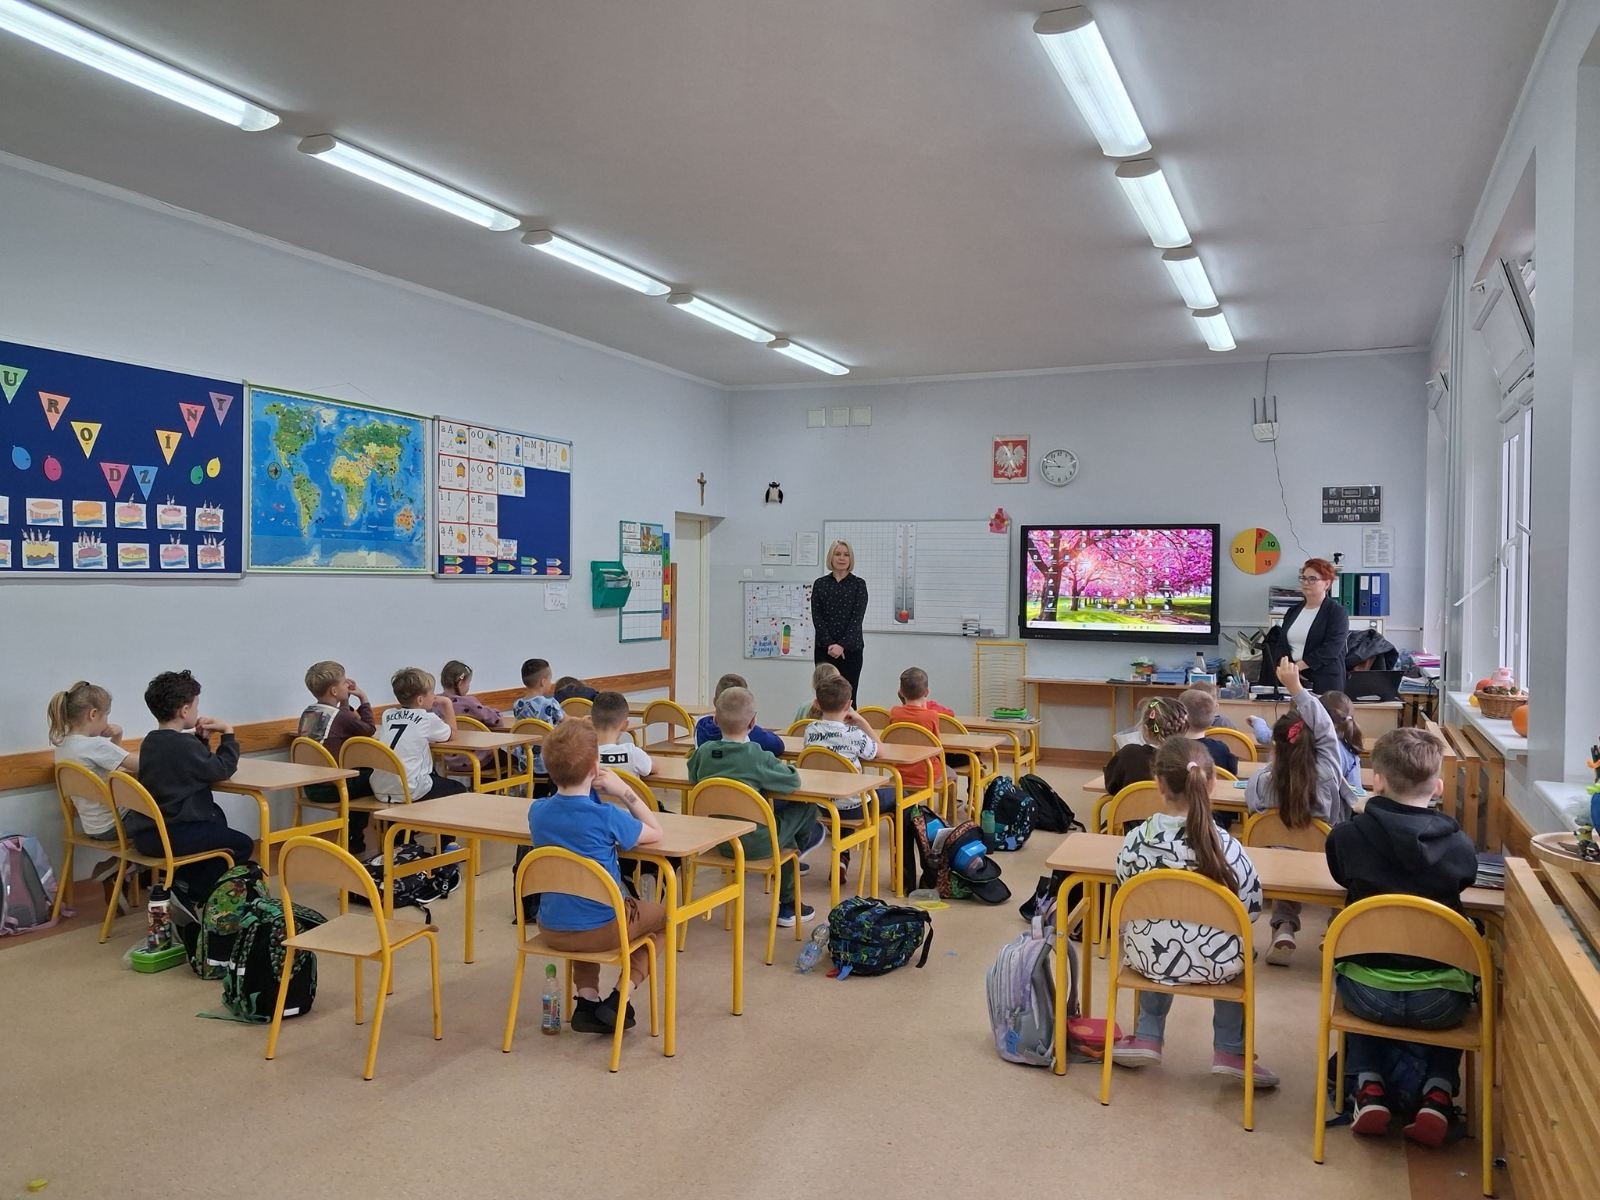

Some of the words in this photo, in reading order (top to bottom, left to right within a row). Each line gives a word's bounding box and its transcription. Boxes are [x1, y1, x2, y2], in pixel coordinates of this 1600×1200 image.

[2, 371, 18, 386] U
[46, 398, 60, 414] R
[80, 427, 93, 442] O
[109, 468, 122, 482] D
[140, 470, 151, 484] Z
[164, 435, 172, 449] I
[186, 408, 198, 421] N
[447, 425, 454, 434] A
[477, 430, 484, 439] O
[478, 496, 483, 504] E
[386, 710, 422, 724] BECKHAM
[389, 724, 408, 750] 7
